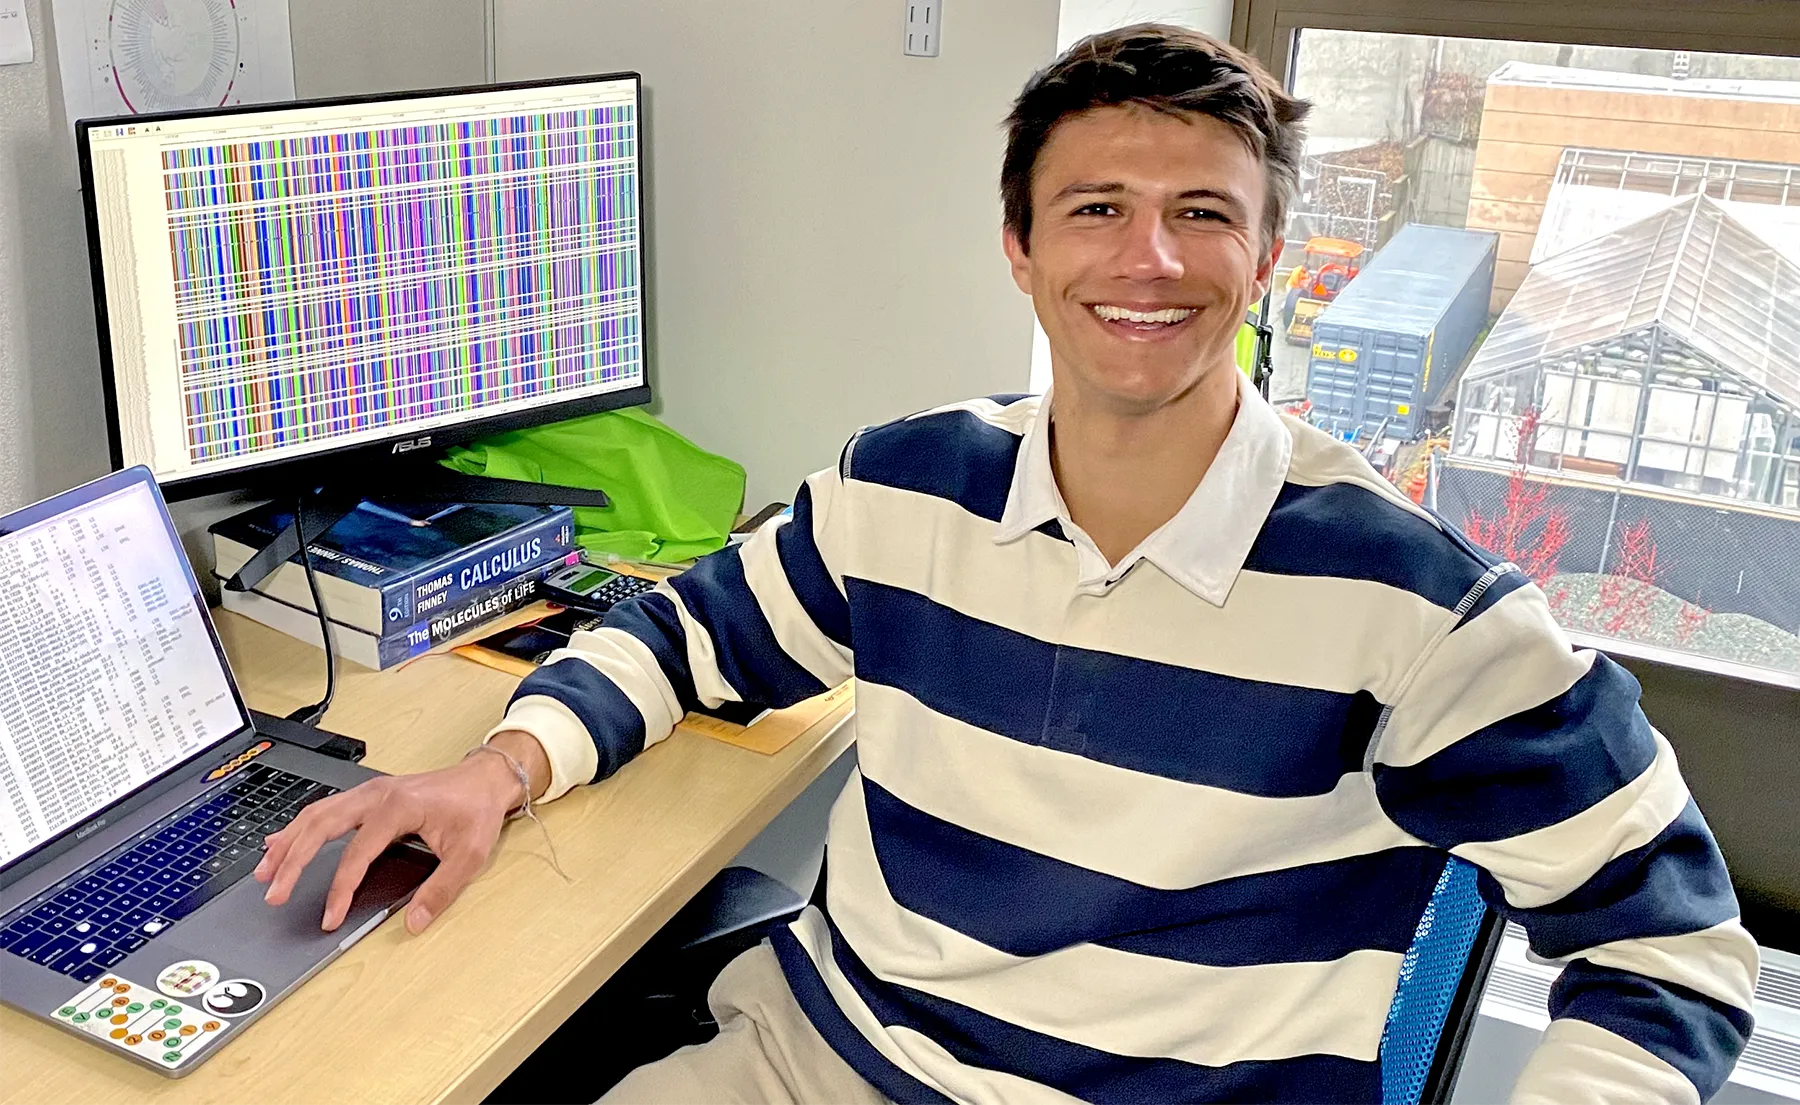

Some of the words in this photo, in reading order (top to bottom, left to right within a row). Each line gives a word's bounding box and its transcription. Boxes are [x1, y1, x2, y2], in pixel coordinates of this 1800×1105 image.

[392, 436, 432, 454] ASUS
[307, 546, 340, 561] FINNE
[341, 558, 385, 575] THOMAS
[459, 537, 542, 591] CALCULUS
[416, 573, 453, 598] THOMAS
[417, 591, 449, 614] FINNEY
[388, 609, 403, 622] 9
[407, 628, 429, 646] The
[431, 598, 500, 637] MOLECULES
[502, 590, 513, 605] of
[514, 580, 536, 602] LIFE
[76, 822, 98, 839] MacBook
[97, 819, 106, 828] Pro
